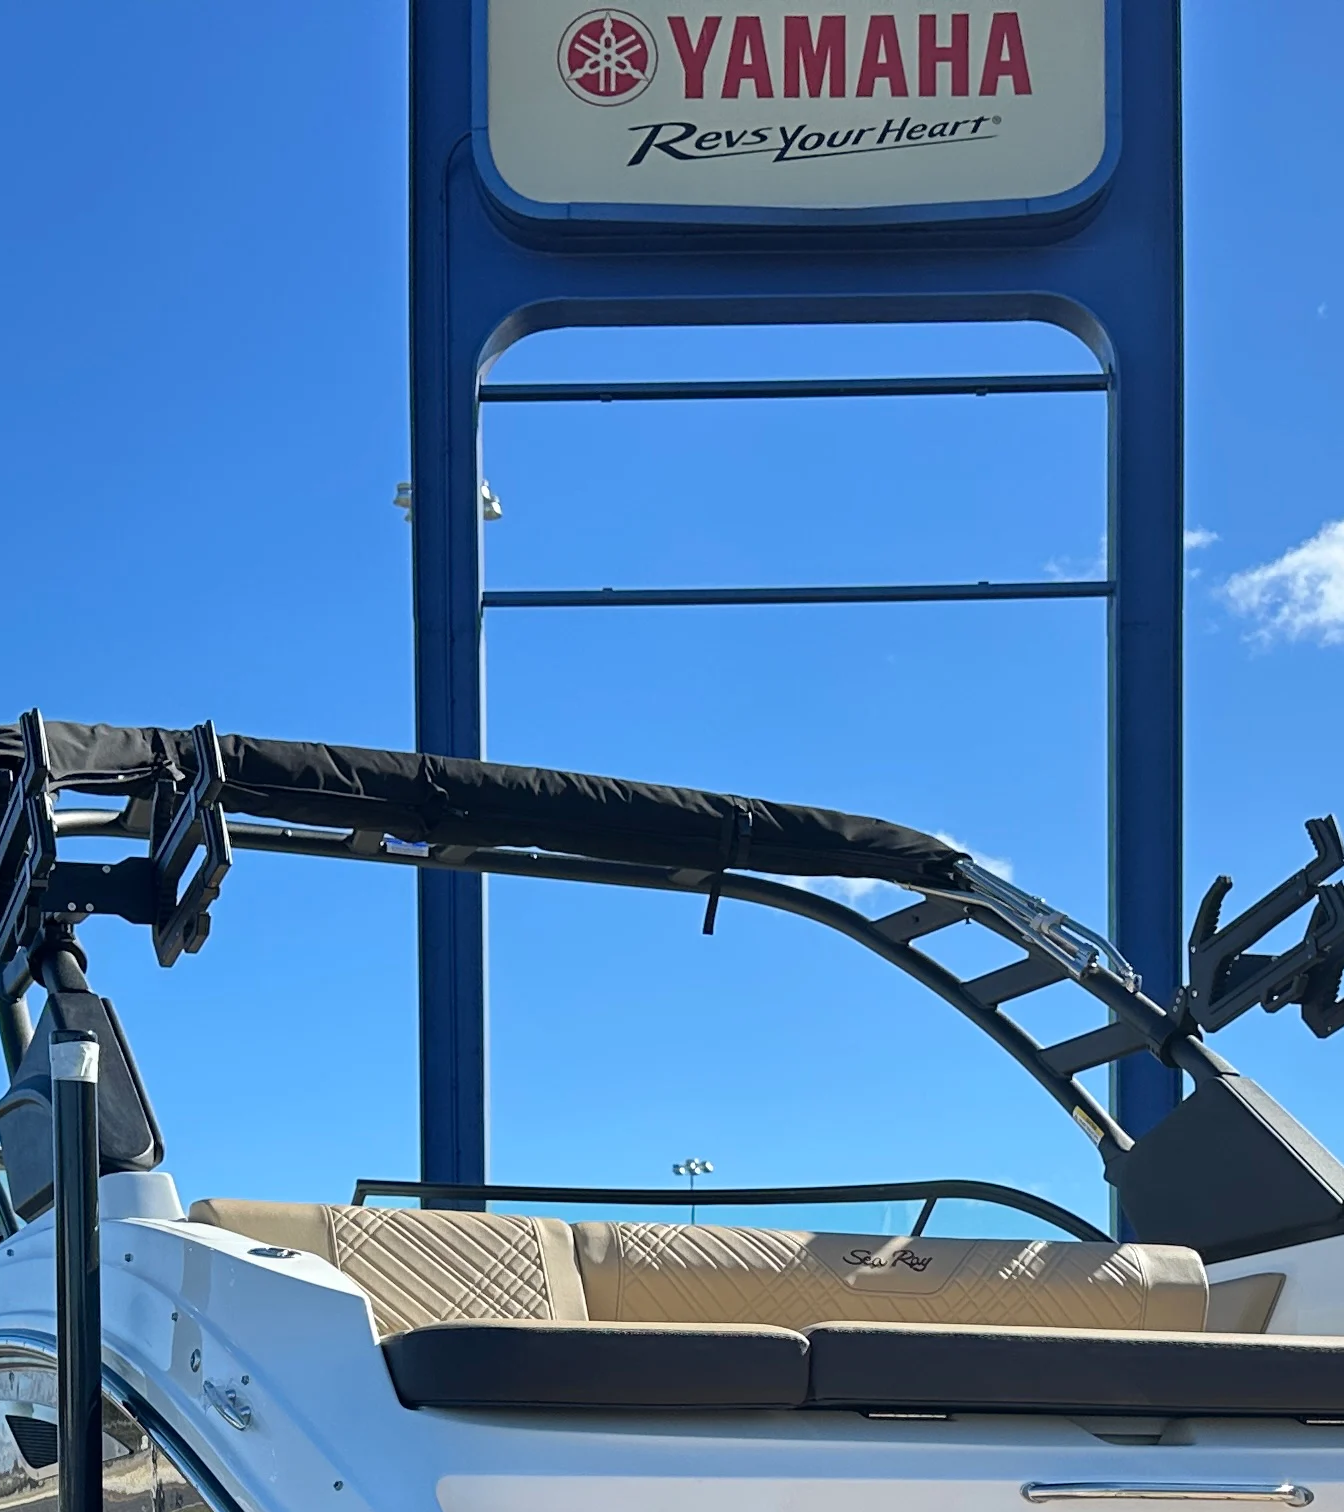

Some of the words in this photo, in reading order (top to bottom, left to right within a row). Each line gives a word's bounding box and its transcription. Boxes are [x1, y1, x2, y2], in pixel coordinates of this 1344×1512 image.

[667, 12, 1032, 99] YAMAHA
[627, 122, 773, 166] Revs
[772, 124, 876, 162] Your
[876, 115, 991, 145] Heart
[842, 1249, 888, 1269] Sea
[891, 1249, 933, 1272] Ray
